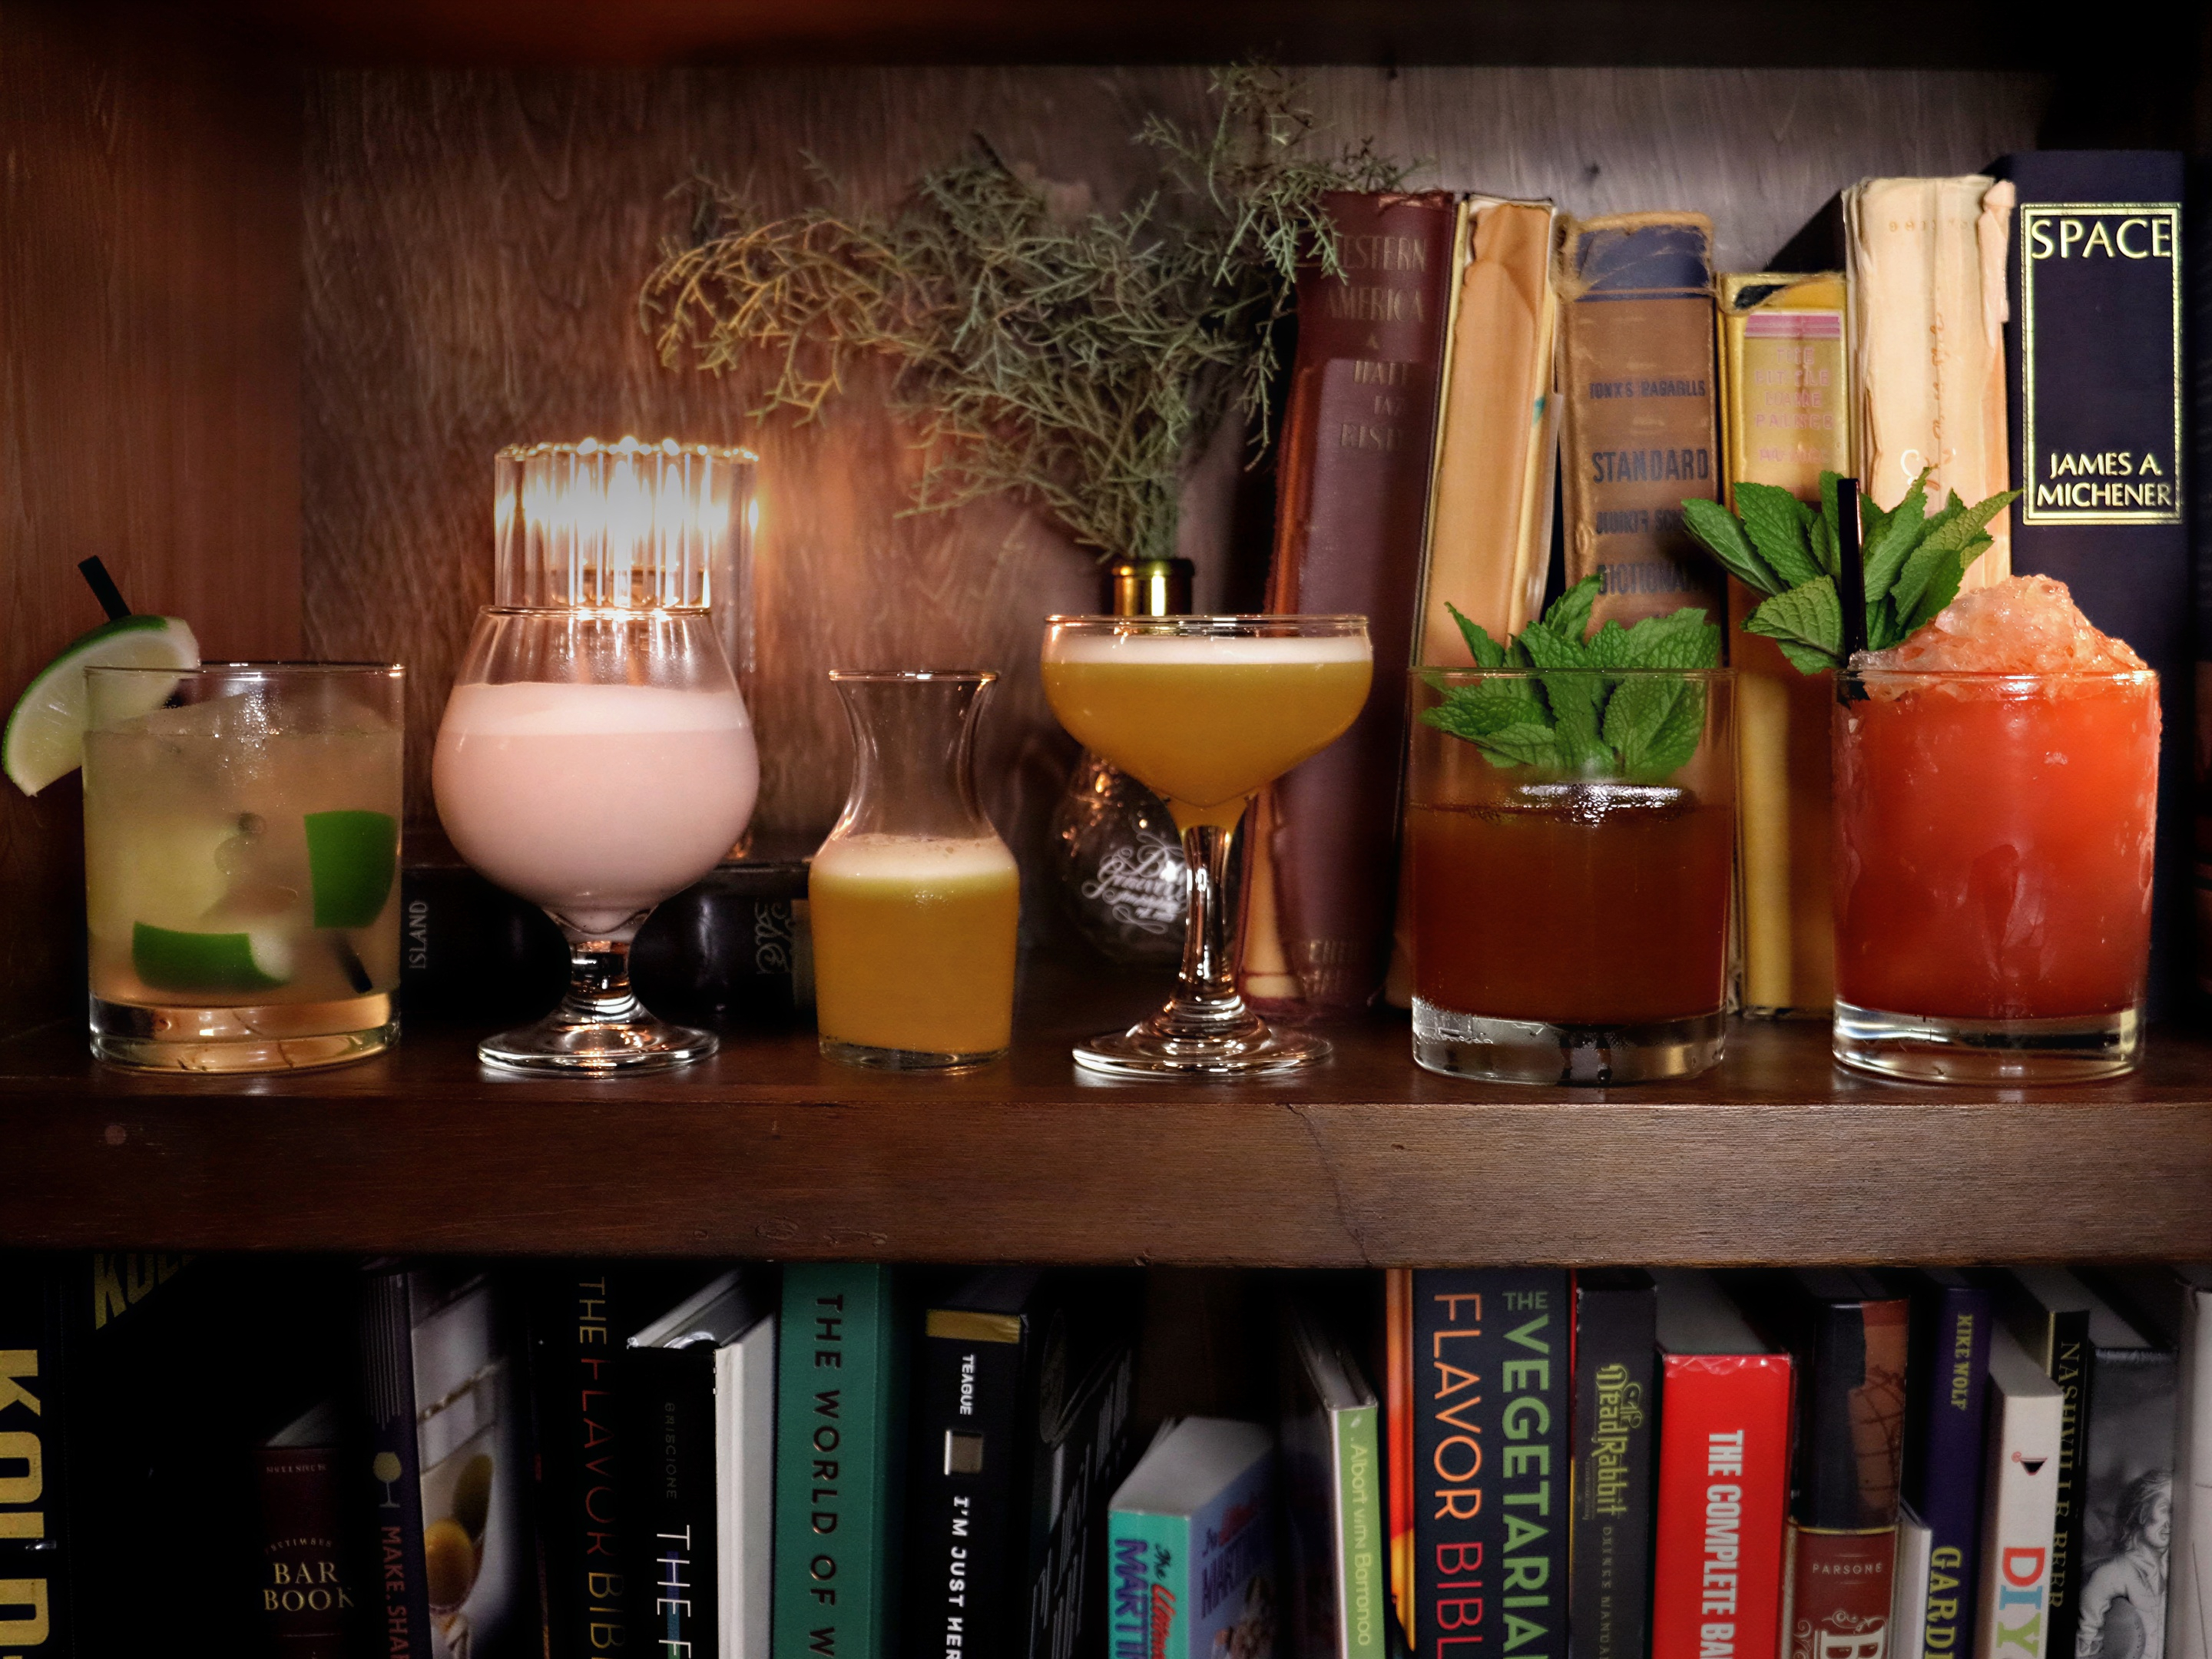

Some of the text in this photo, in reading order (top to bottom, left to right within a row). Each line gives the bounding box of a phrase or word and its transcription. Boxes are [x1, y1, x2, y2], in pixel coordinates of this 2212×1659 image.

[2032, 217, 2173, 260] SPACE
[1591, 449, 1709, 484] STANDARD
[2049, 452, 2133, 480] JAMES
[2037, 482, 2173, 508] MICHENER
[409, 900, 428, 969] ISLAND
[1502, 1292, 1548, 1311] THE
[815, 1294, 843, 1369] THE
[959, 1354, 975, 1416] TEAGUE
[1433, 1293, 1482, 1520] FLAVOR
[1951, 1362, 1971, 1410] WOLF
[578, 1277, 626, 1659] THE FLAVOR BIB
[811, 1389, 842, 1535] WORLD
[1707, 1430, 1744, 1477] THE
[1502, 1314, 1551, 1659] VEGETARIA
[953, 1497, 970, 1535] I'M
[273, 1561, 339, 1584] BAR
[656, 1525, 691, 1618] THE
[1154, 1544, 1171, 1581] The
[1701, 1486, 1742, 1616] COMPLETE
[263, 1587, 355, 1611] BOOK
[809, 1555, 837, 1606] OF
[949, 1547, 967, 1608] JUST
[1995, 1546, 2045, 1658] DIY
